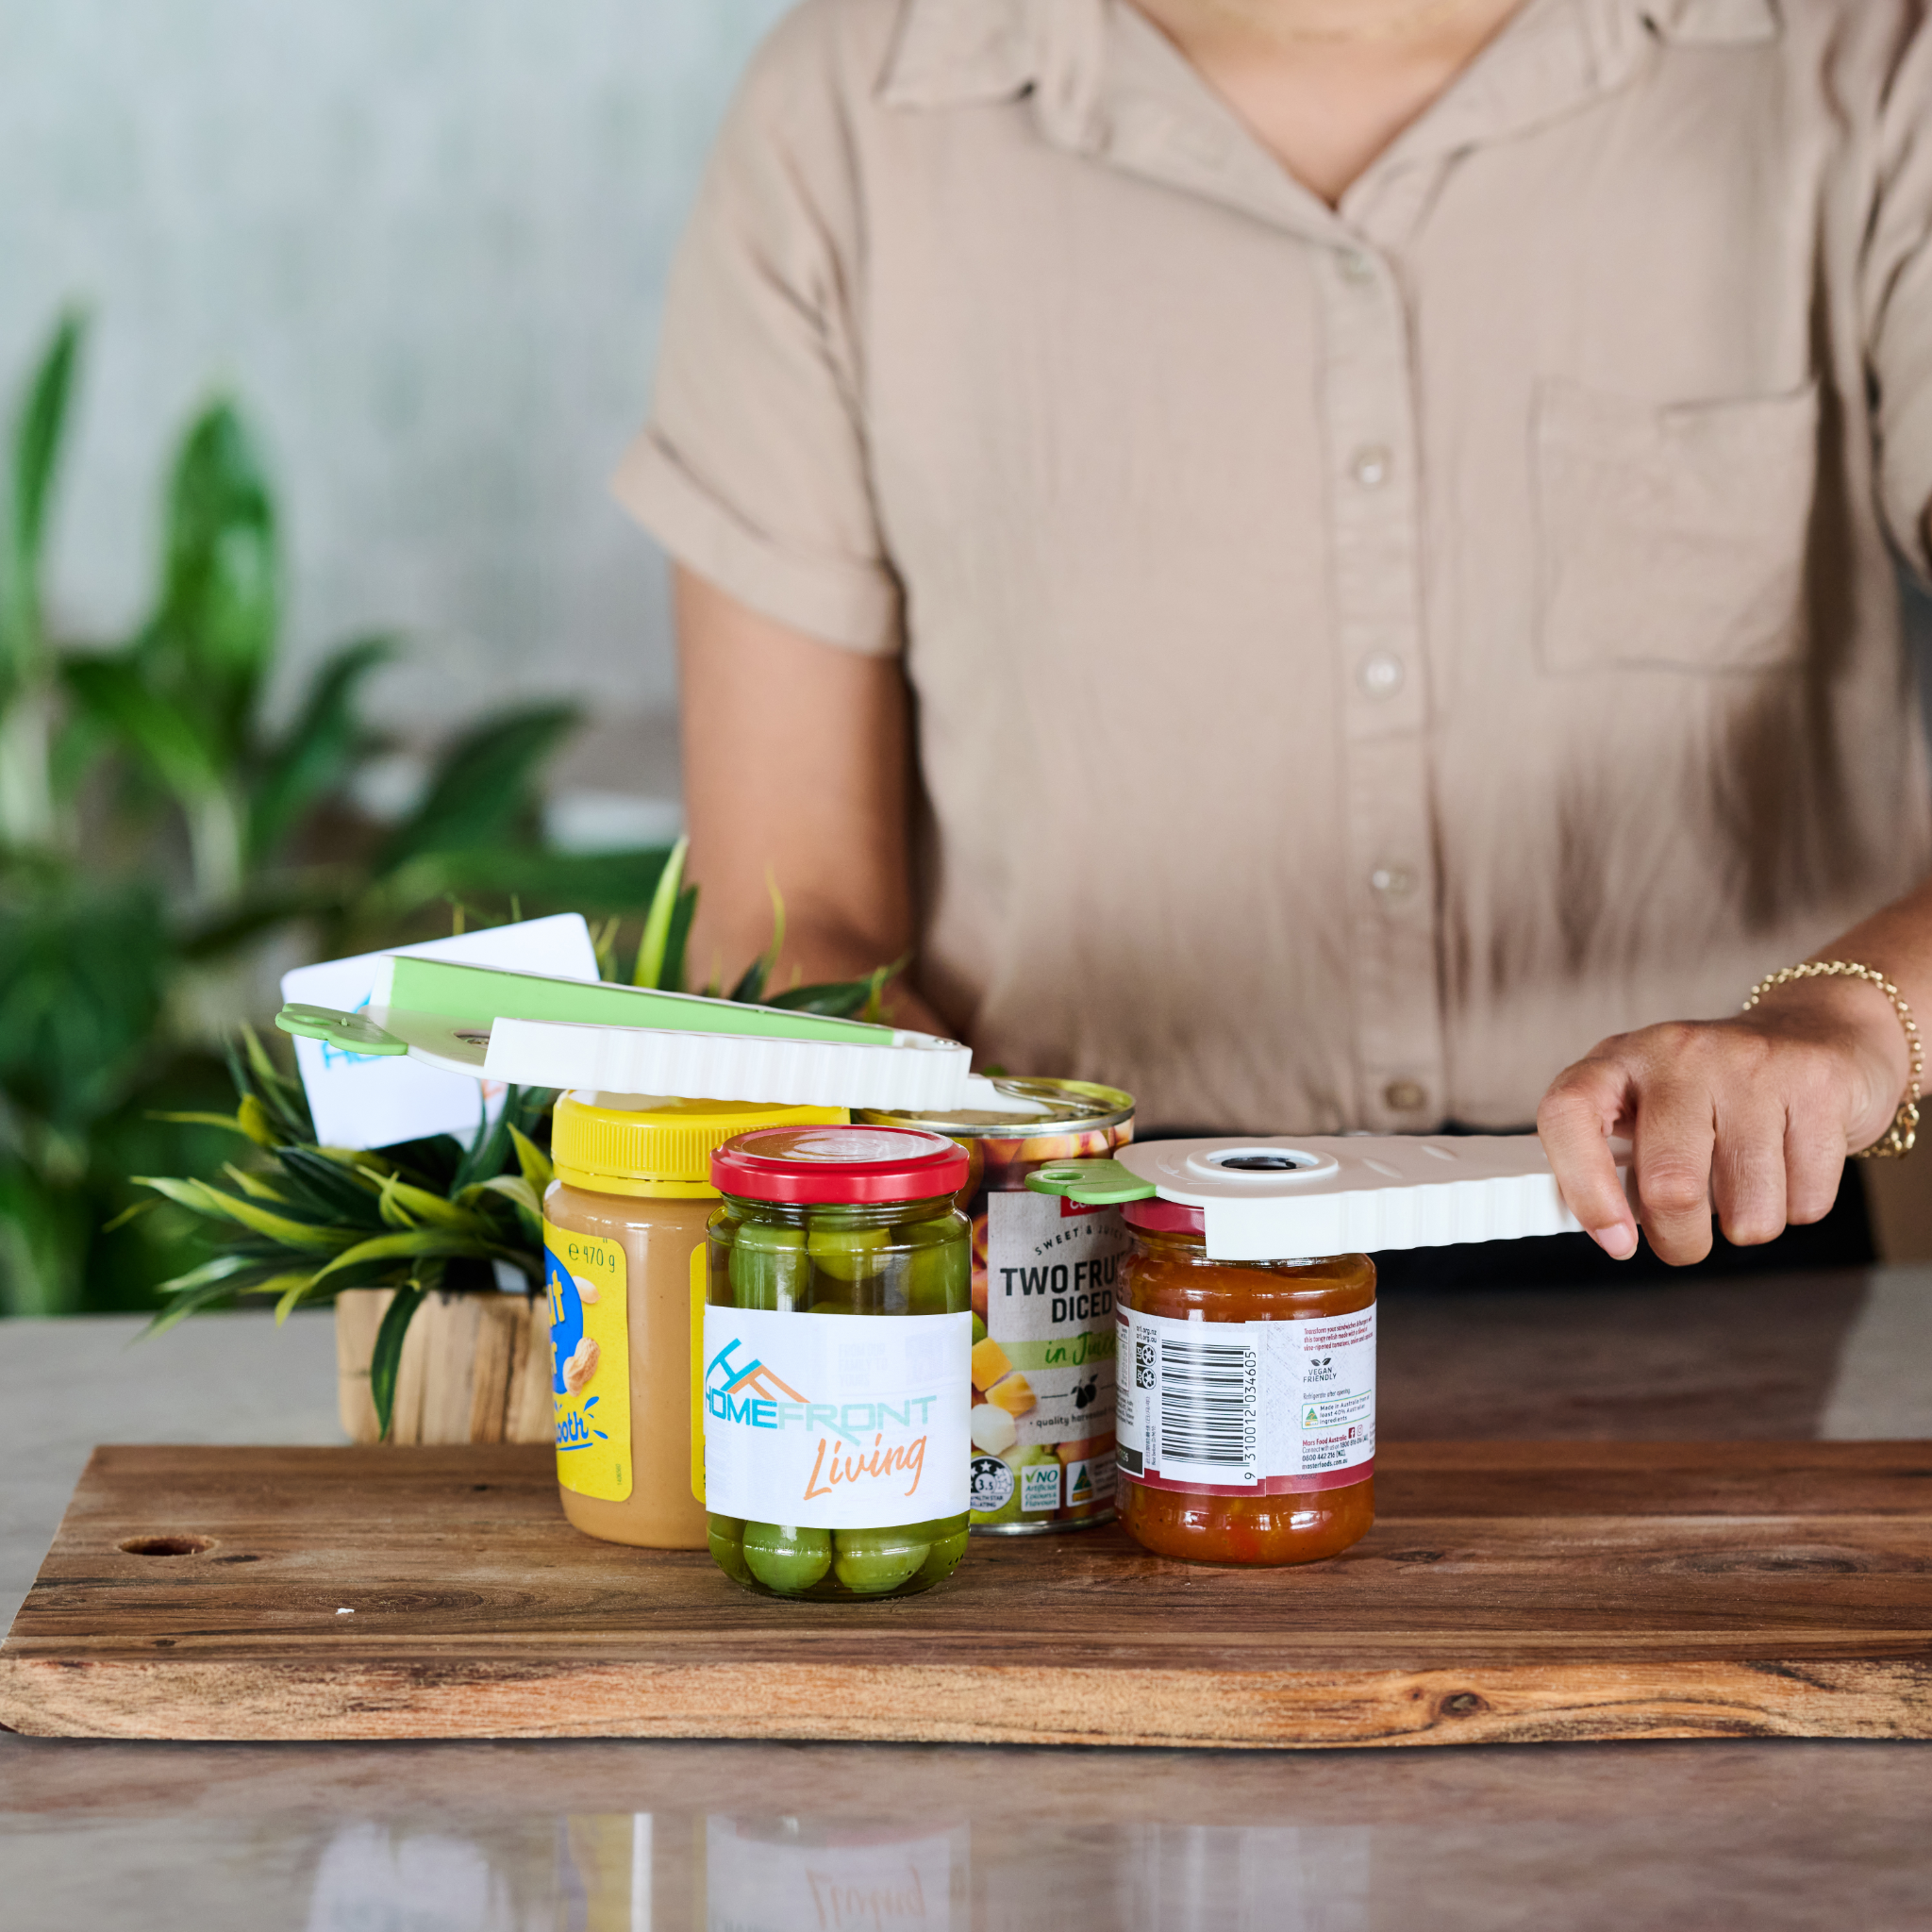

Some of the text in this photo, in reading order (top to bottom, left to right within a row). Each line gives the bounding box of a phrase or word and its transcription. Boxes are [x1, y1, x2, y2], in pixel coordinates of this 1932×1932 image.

[1035, 1228, 1079, 1256] SWEET
[1086, 1225, 1092, 1235] &
[584, 1245, 604, 1266] 470
[608, 1255, 615, 1274] g
[1000, 1265, 1068, 1296] TWO
[1052, 1290, 1112, 1324] DICED
[1326, 1333, 1338, 1341] relish
[1044, 1341, 1067, 1364] in
[1303, 1373, 1338, 1383] FRIENDLY
[1307, 1367, 1333, 1376] VEGAN
[1341, 1399, 1359, 1407] Australia
[705, 1385, 938, 1447] HOMEFRONT
[1036, 1415, 1070, 1428] quality
[1244, 1351, 1257, 1480] 9 310012 034605
[1320, 1415, 1347, 1425] ingredients
[556, 1411, 590, 1444] ooth
[1302, 1434, 1347, 1447] Mars Food Australia
[1327, 1451, 1336, 1459] 216
[803, 1433, 927, 1501] Living
[1302, 1457, 1348, 1470] masterfoods.com.au
[1036, 1470, 1058, 1483] NO
[978, 1479, 993, 1491] 3.5
[1025, 1483, 1057, 1492] Artificial
[1025, 1499, 1057, 1507] Flavours
